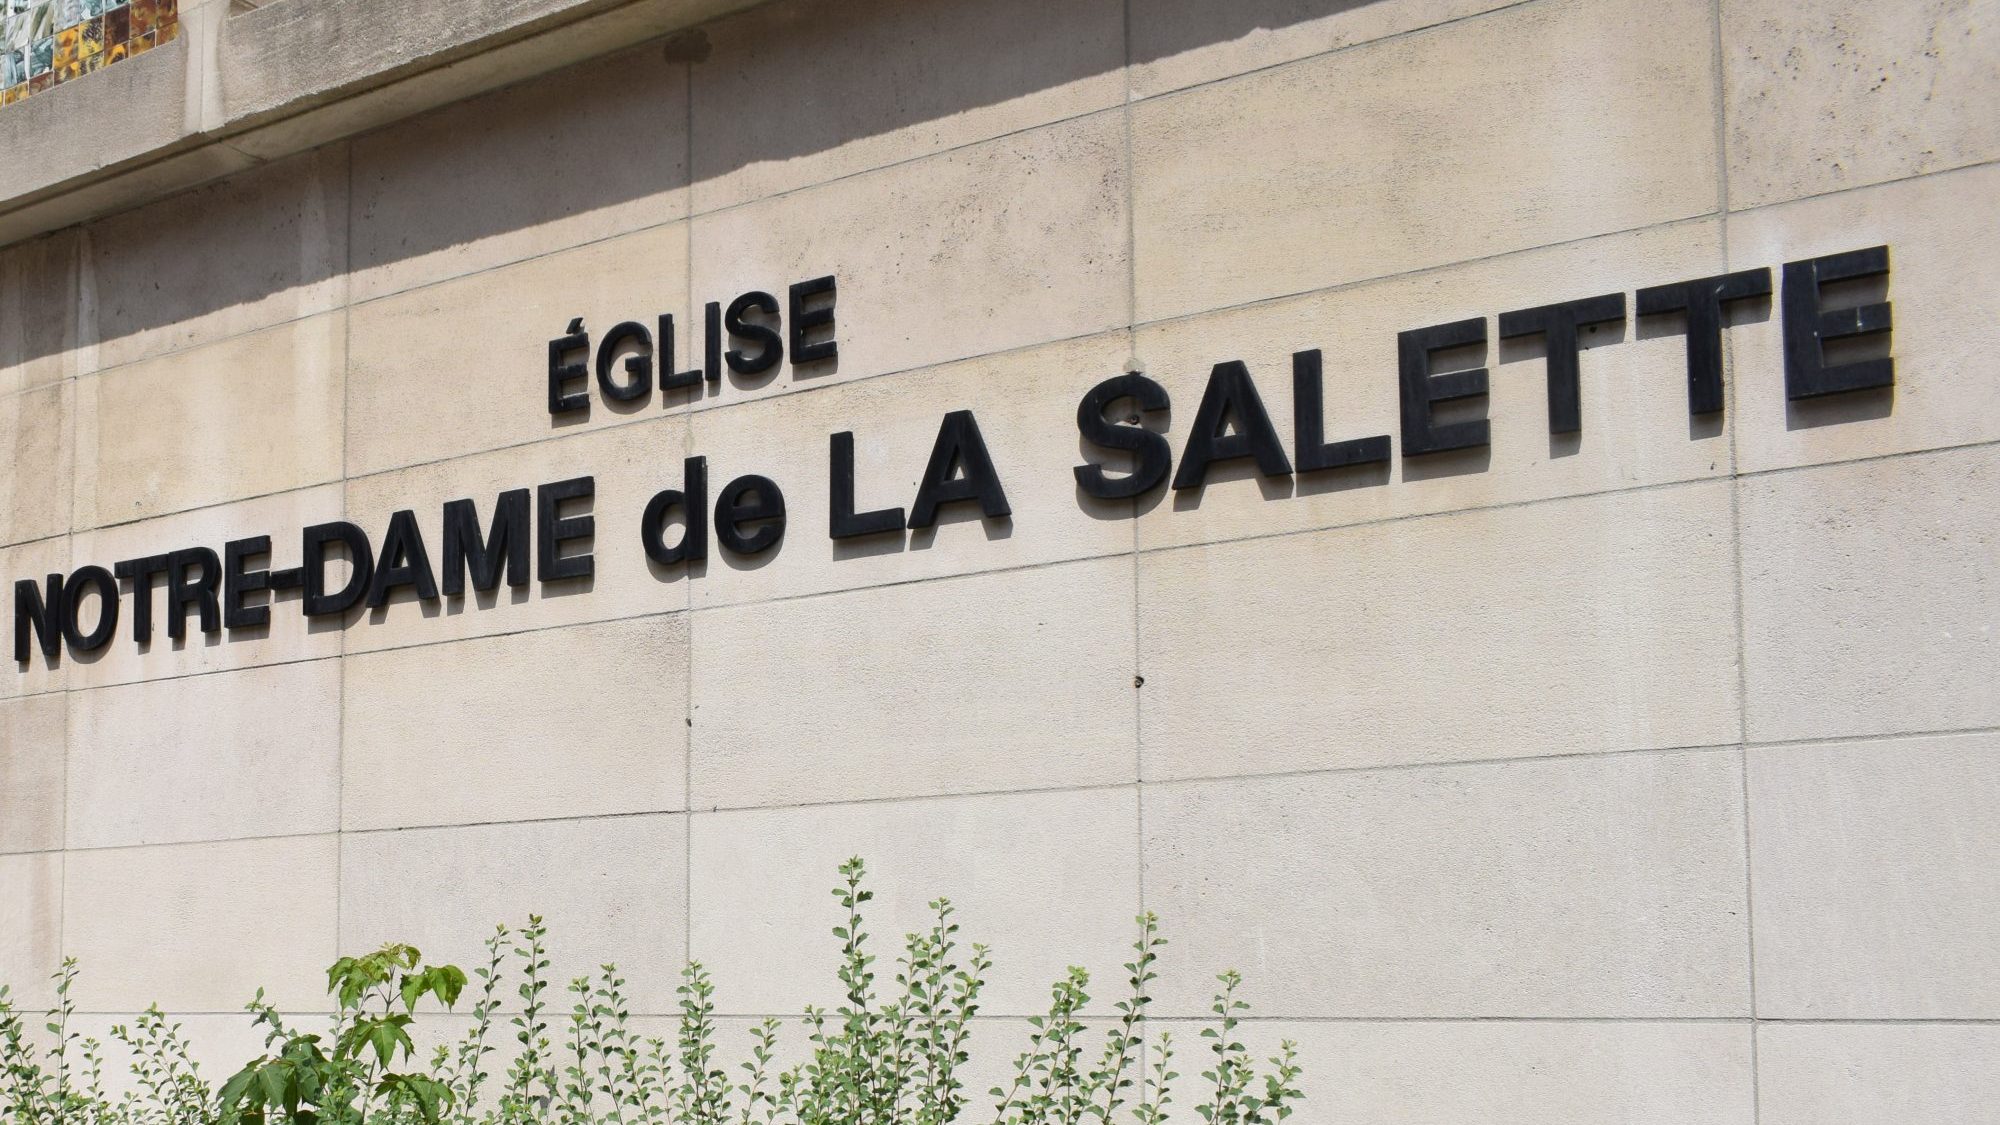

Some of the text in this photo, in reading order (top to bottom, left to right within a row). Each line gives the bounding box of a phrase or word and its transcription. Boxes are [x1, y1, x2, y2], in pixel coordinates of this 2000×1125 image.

[14, 245, 1895, 662] NOTRE-DAME de LA SALETTE
[548, 275, 838, 415] ÉGLISE
